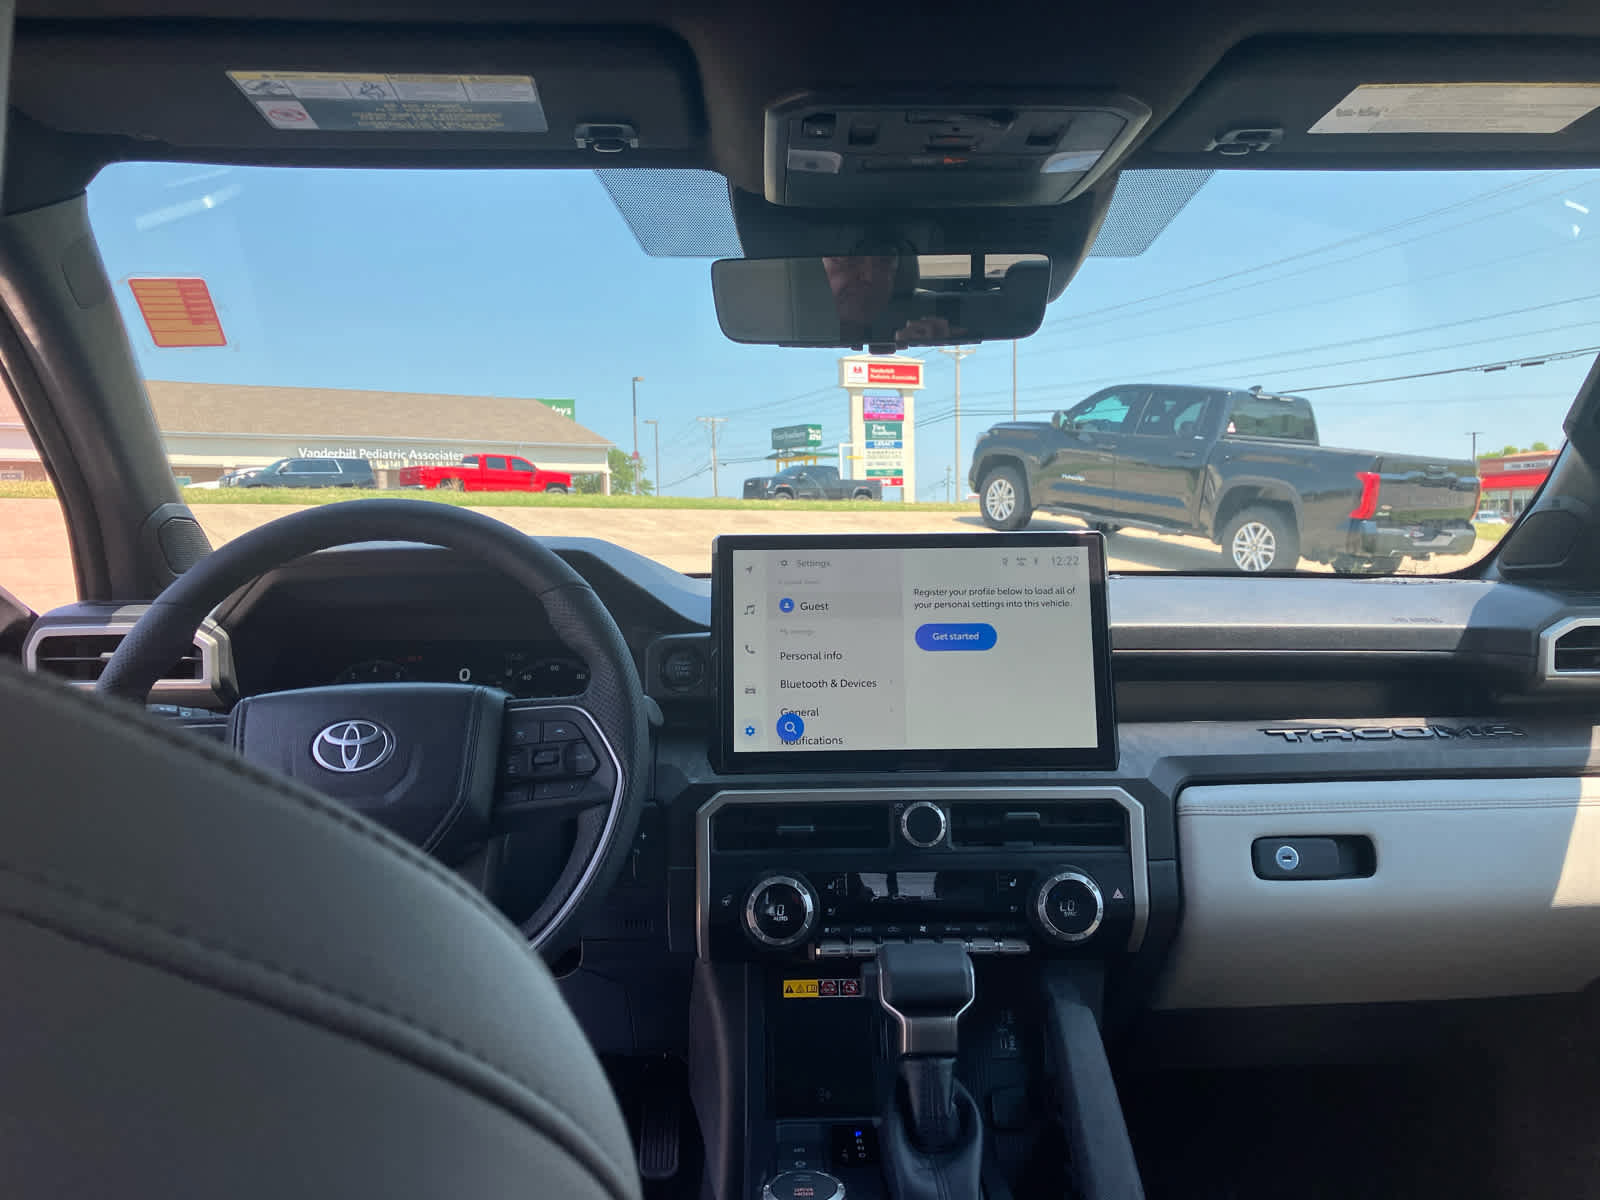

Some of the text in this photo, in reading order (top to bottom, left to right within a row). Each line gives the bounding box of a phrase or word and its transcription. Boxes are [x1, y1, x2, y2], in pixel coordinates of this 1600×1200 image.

[298, 447, 464, 460] Vanderbilt Pediatric Associates
[796, 560, 830, 568] Settings
[1051, 555, 1079, 567] 12:22
[914, 586, 1076, 598] Register your profile below to load all of
[800, 601, 829, 611] Guest
[914, 602, 932, 610] your
[934, 600, 969, 610] personal
[971, 599, 1004, 610] settings
[1006, 599, 1022, 608] into
[1024, 599, 1040, 608] this
[932, 632, 979, 641] Get started
[780, 651, 843, 661] Personal info
[459, 668, 471, 681] 0
[780, 678, 877, 689] Bluetooth & Devices
[780, 707, 819, 717] General
[1262, 724, 1528, 743] TACOMA
[781, 735, 843, 745] Notifications
